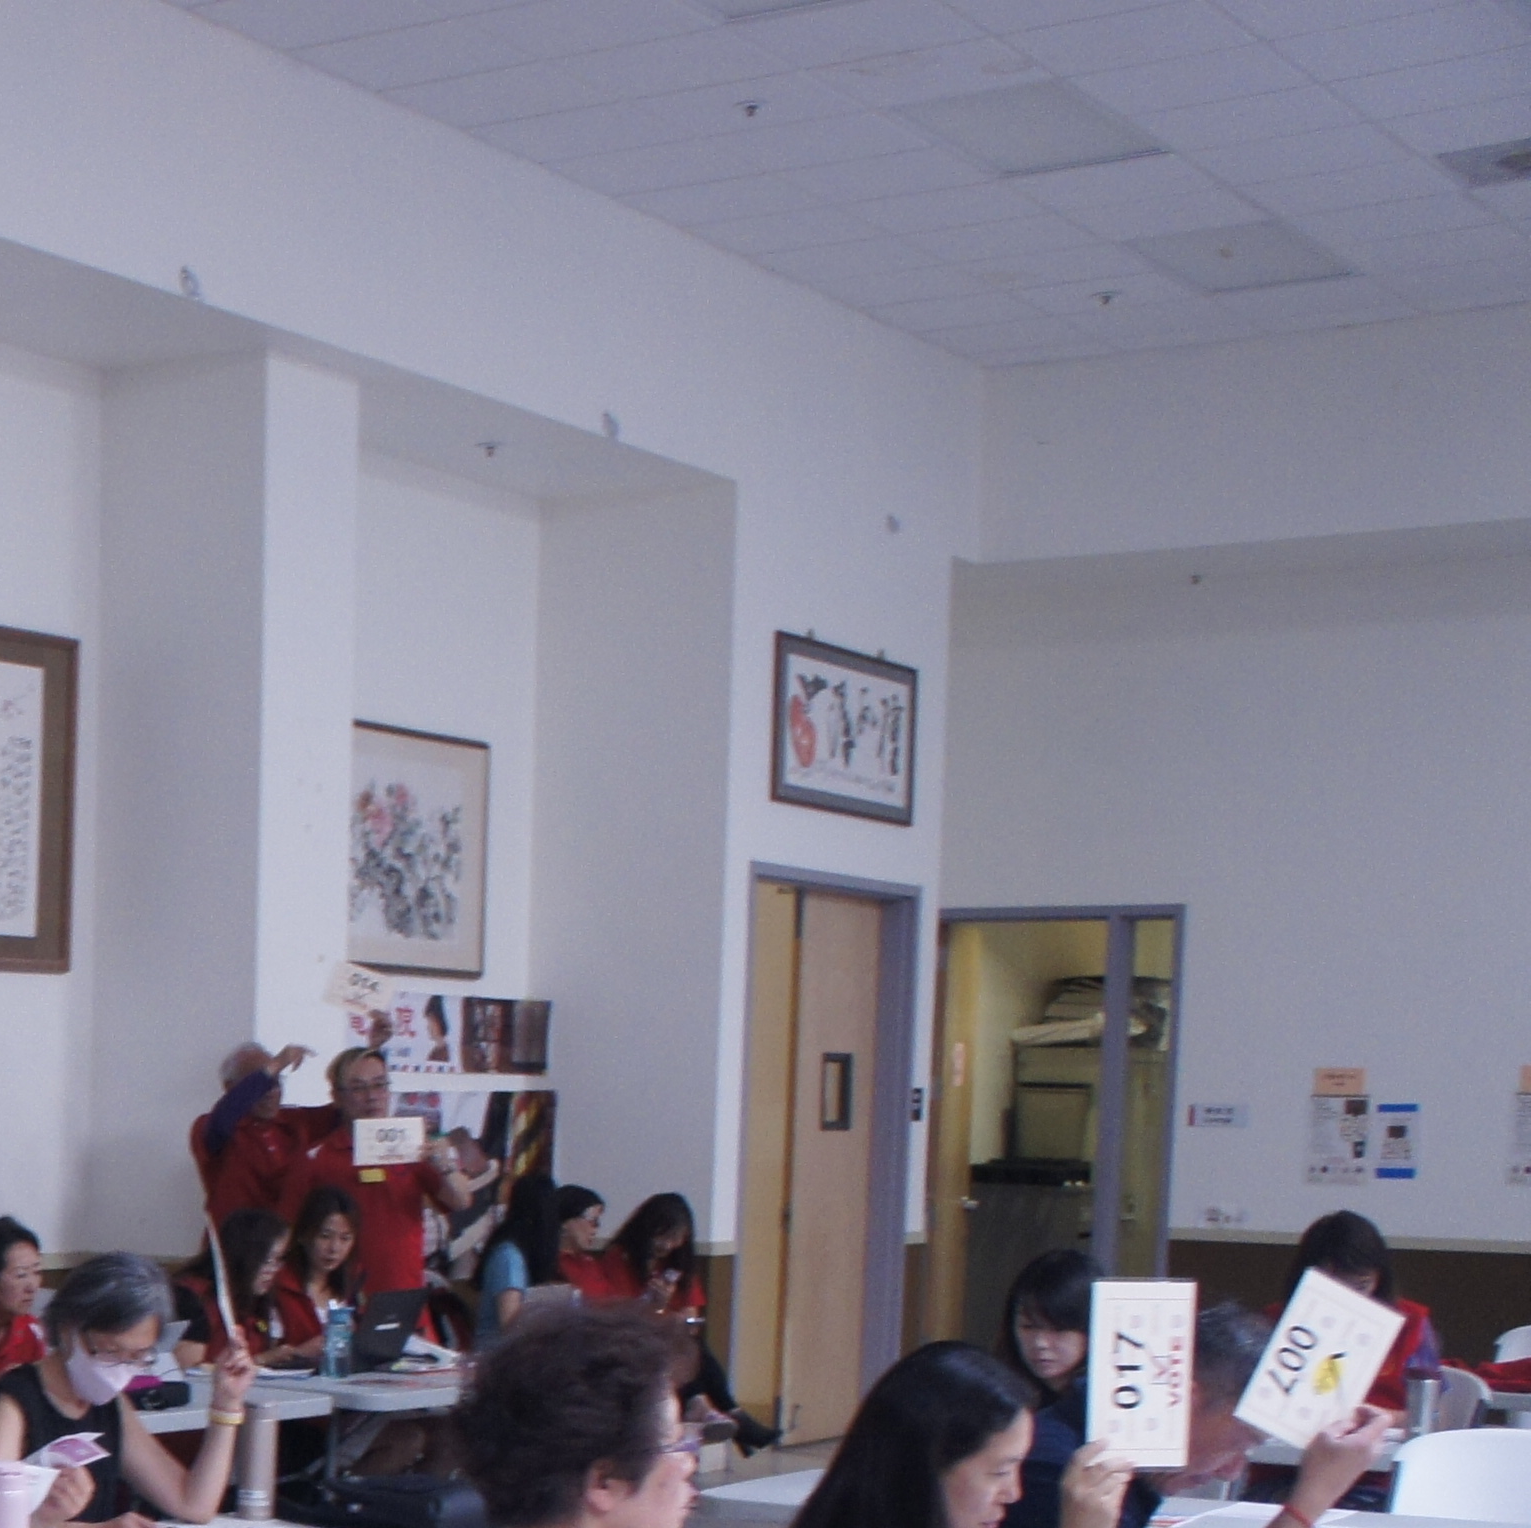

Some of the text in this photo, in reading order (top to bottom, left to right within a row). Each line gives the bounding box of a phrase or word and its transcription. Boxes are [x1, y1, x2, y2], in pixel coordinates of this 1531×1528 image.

[1111, 1332, 1145, 1410] 017
[1167, 1336, 1182, 1408] VOTE
[1268, 1324, 1319, 1396] 007
